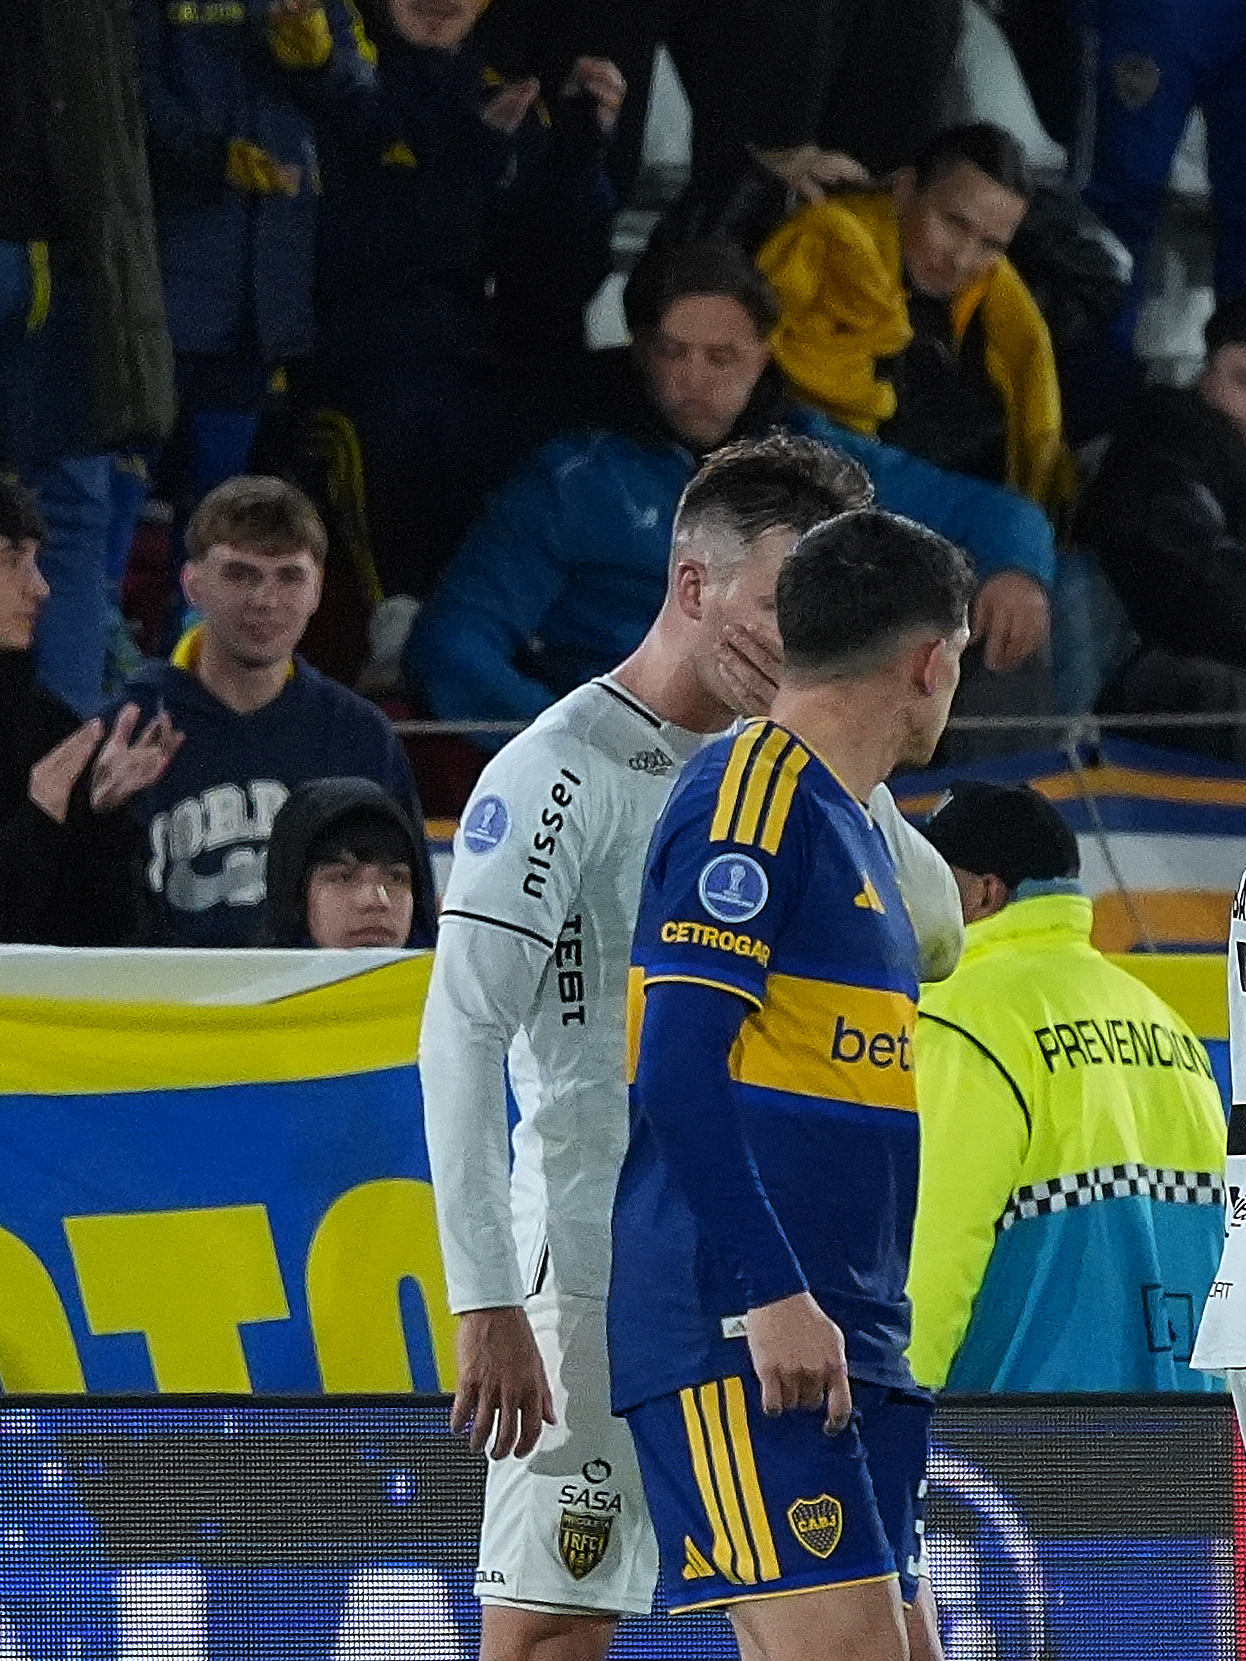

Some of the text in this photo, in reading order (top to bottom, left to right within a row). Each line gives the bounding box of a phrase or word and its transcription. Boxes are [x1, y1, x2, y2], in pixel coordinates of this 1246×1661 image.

[523, 768, 581, 899] nissei
[661, 920, 771, 968] CETROGAR
[831, 1016, 910, 1072] bet
[1034, 1019, 1213, 1080] PREVENCION
[559, 1485, 622, 1513] SASA
